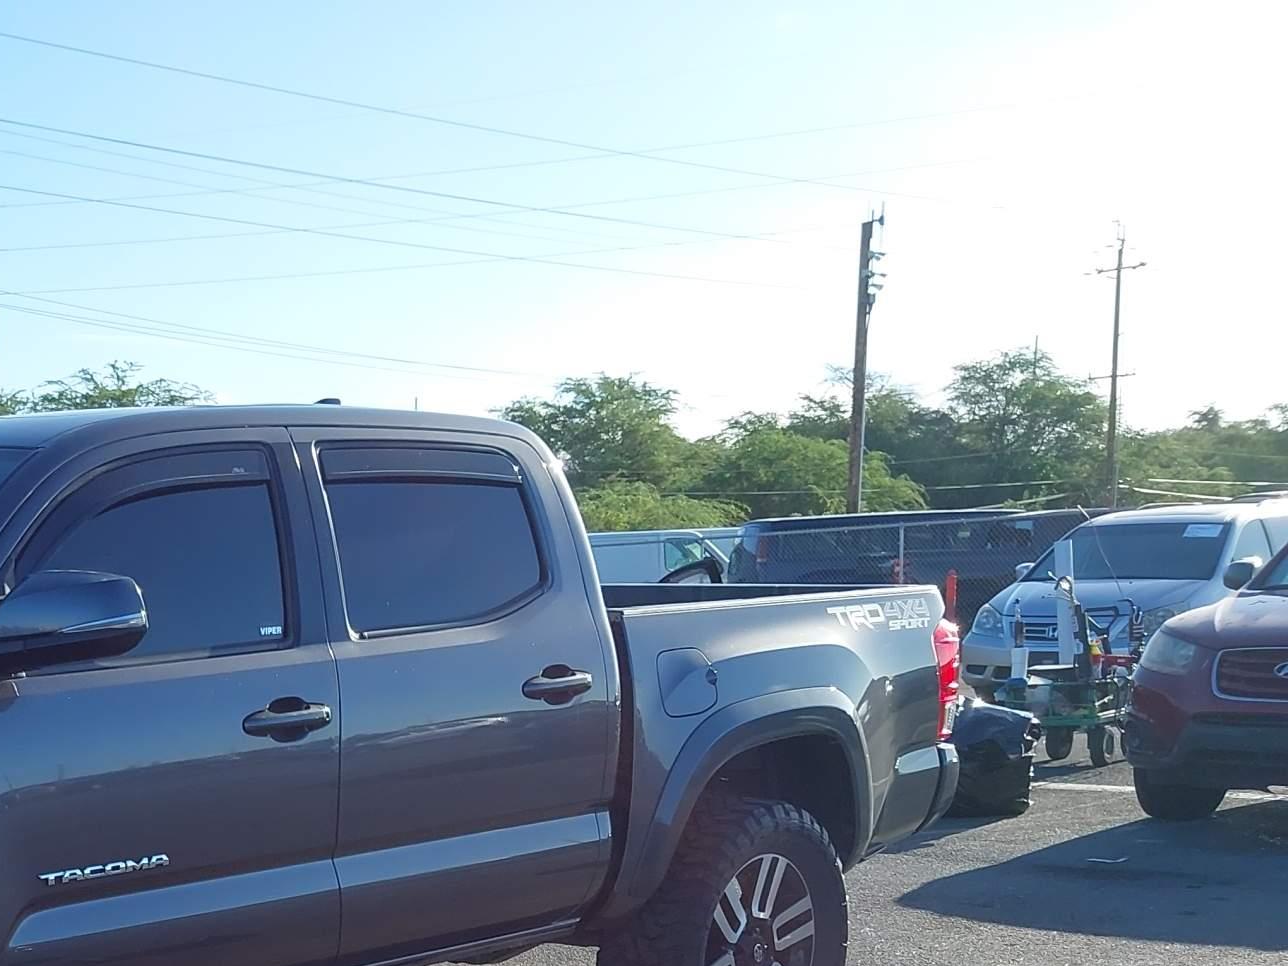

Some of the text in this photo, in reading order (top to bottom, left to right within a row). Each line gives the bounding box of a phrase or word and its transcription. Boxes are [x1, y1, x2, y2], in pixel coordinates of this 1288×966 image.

[826, 603, 886, 631] TRD
[888, 617, 931, 631] SPORT
[259, 625, 283, 636] VIPER
[38, 853, 170, 886] TACOMA
